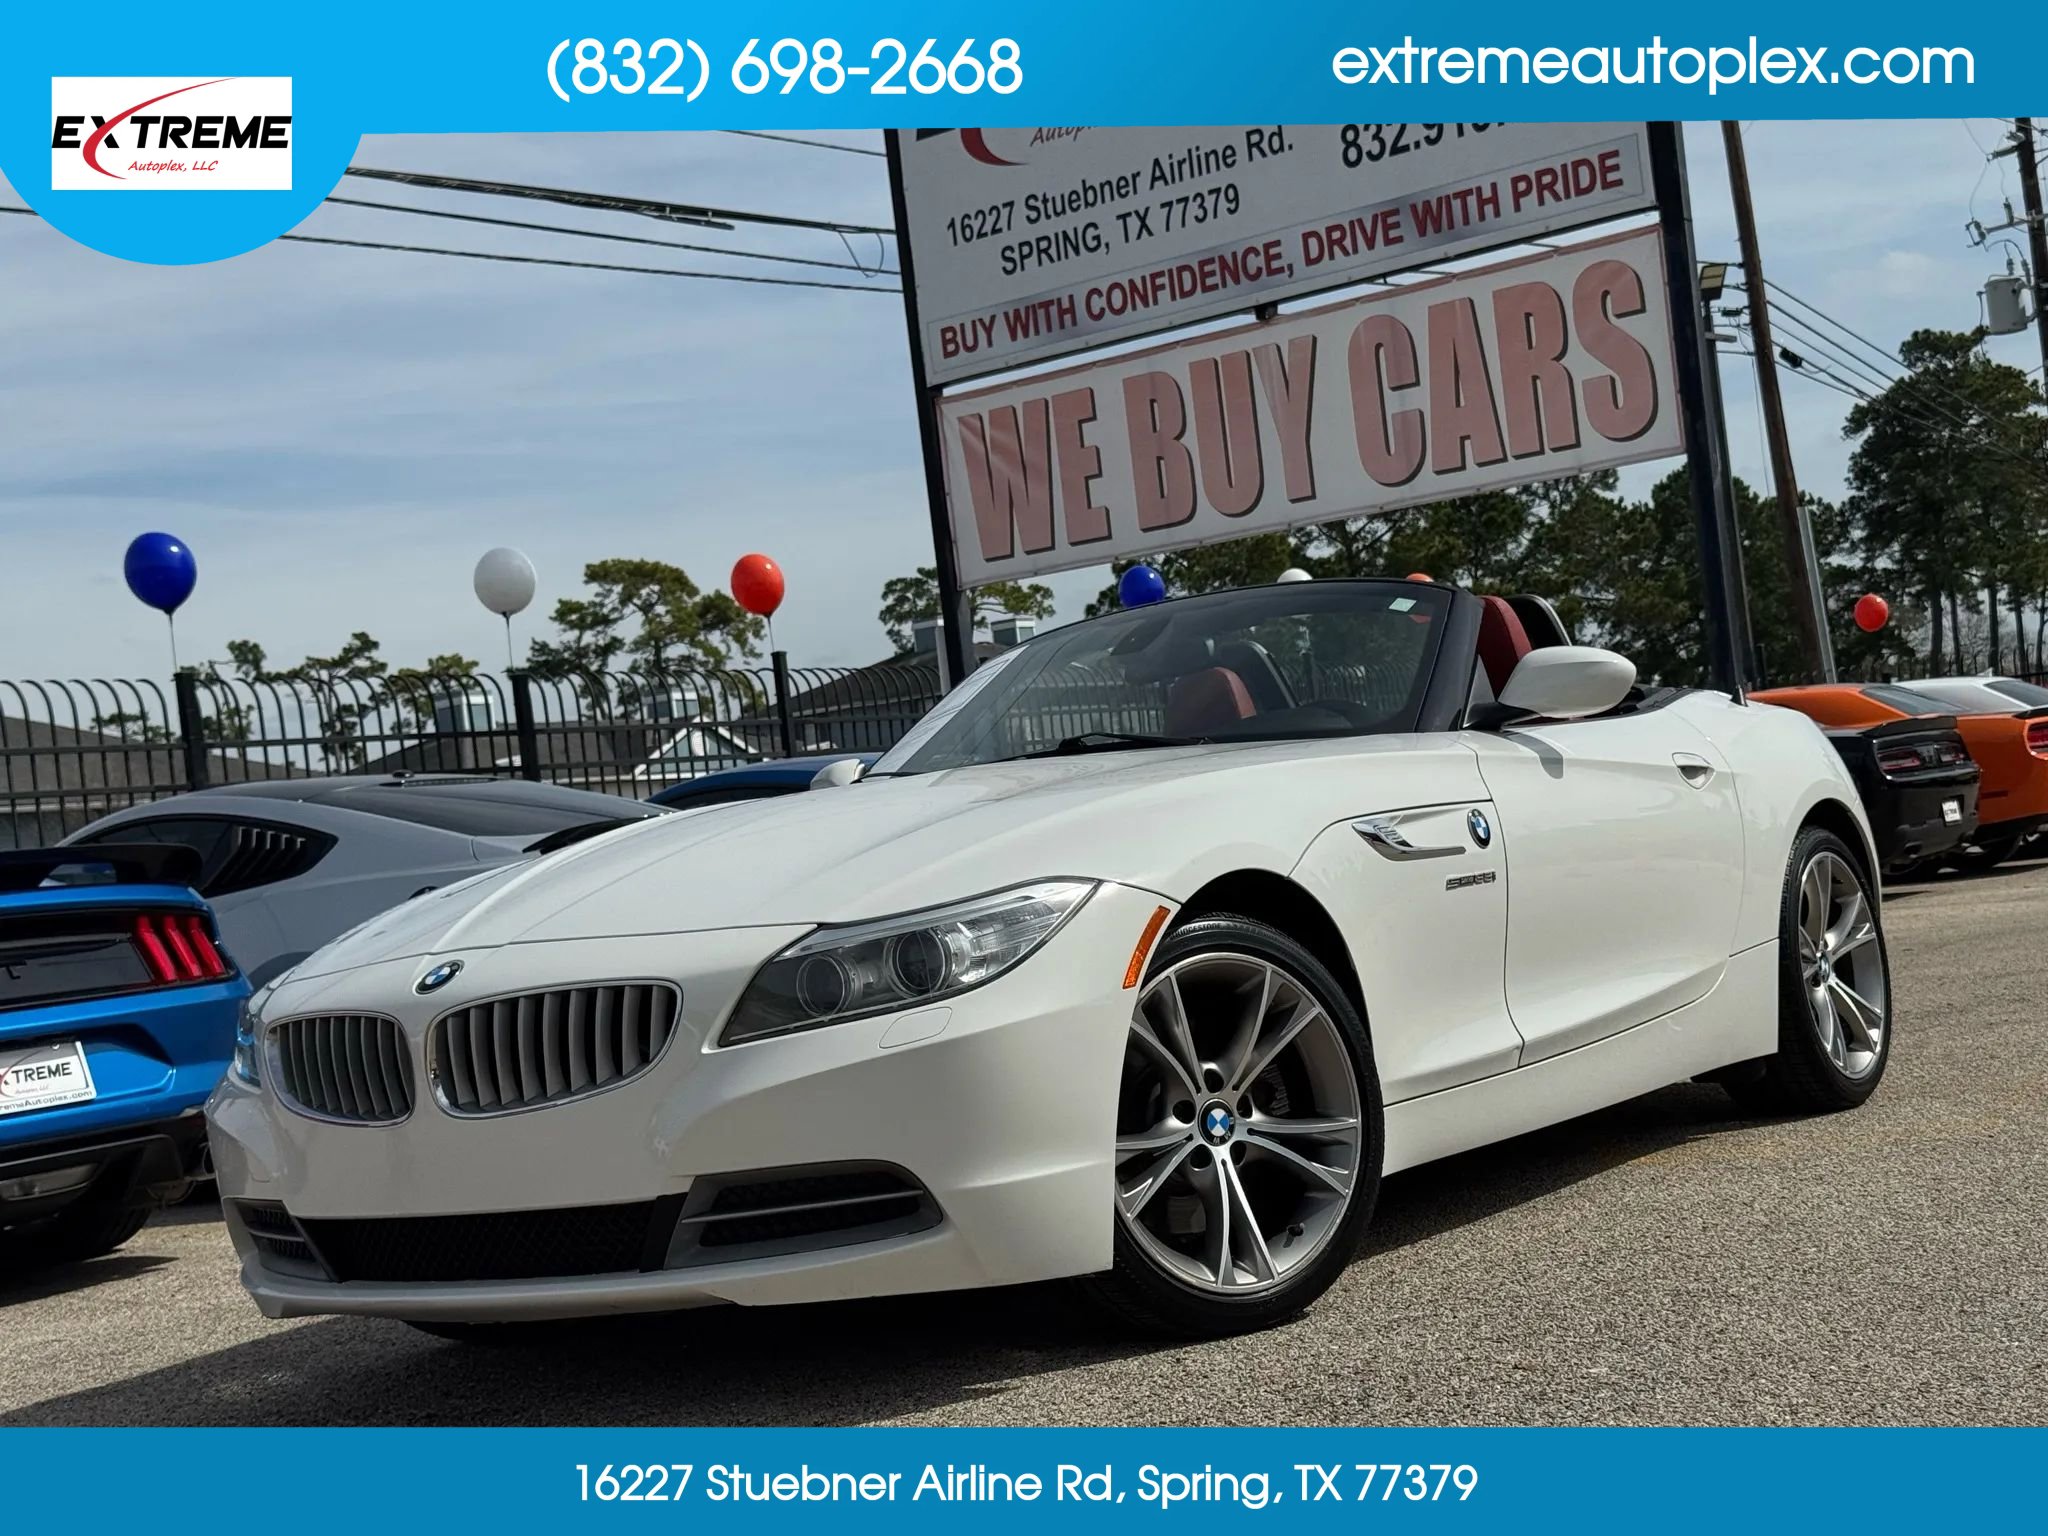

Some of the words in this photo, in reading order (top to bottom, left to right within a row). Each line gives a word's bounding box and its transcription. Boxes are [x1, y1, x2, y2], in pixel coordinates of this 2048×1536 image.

[940, 314, 996, 359] BUY
[1003, 294, 1077, 342] WITH
[1085, 240, 1294, 322] CONFIDENCE,
[1302, 207, 1404, 267] DRIVE
[1410, 181, 1501, 238] WITH
[1510, 149, 1624, 213] PRIDE
[947, 200, 1015, 247] 16227
[1024, 171, 1141, 225] Stuebner
[1149, 144, 1237, 191] Airline
[1245, 125, 1293, 162] Rd.
[1001, 222, 1110, 276] SPRING,
[1116, 206, 1154, 244] TX
[1160, 183, 1240, 232] 77379
[958, 386, 1112, 562] WE
[1122, 334, 1317, 532] BUY
[1347, 259, 1659, 492] CARS
